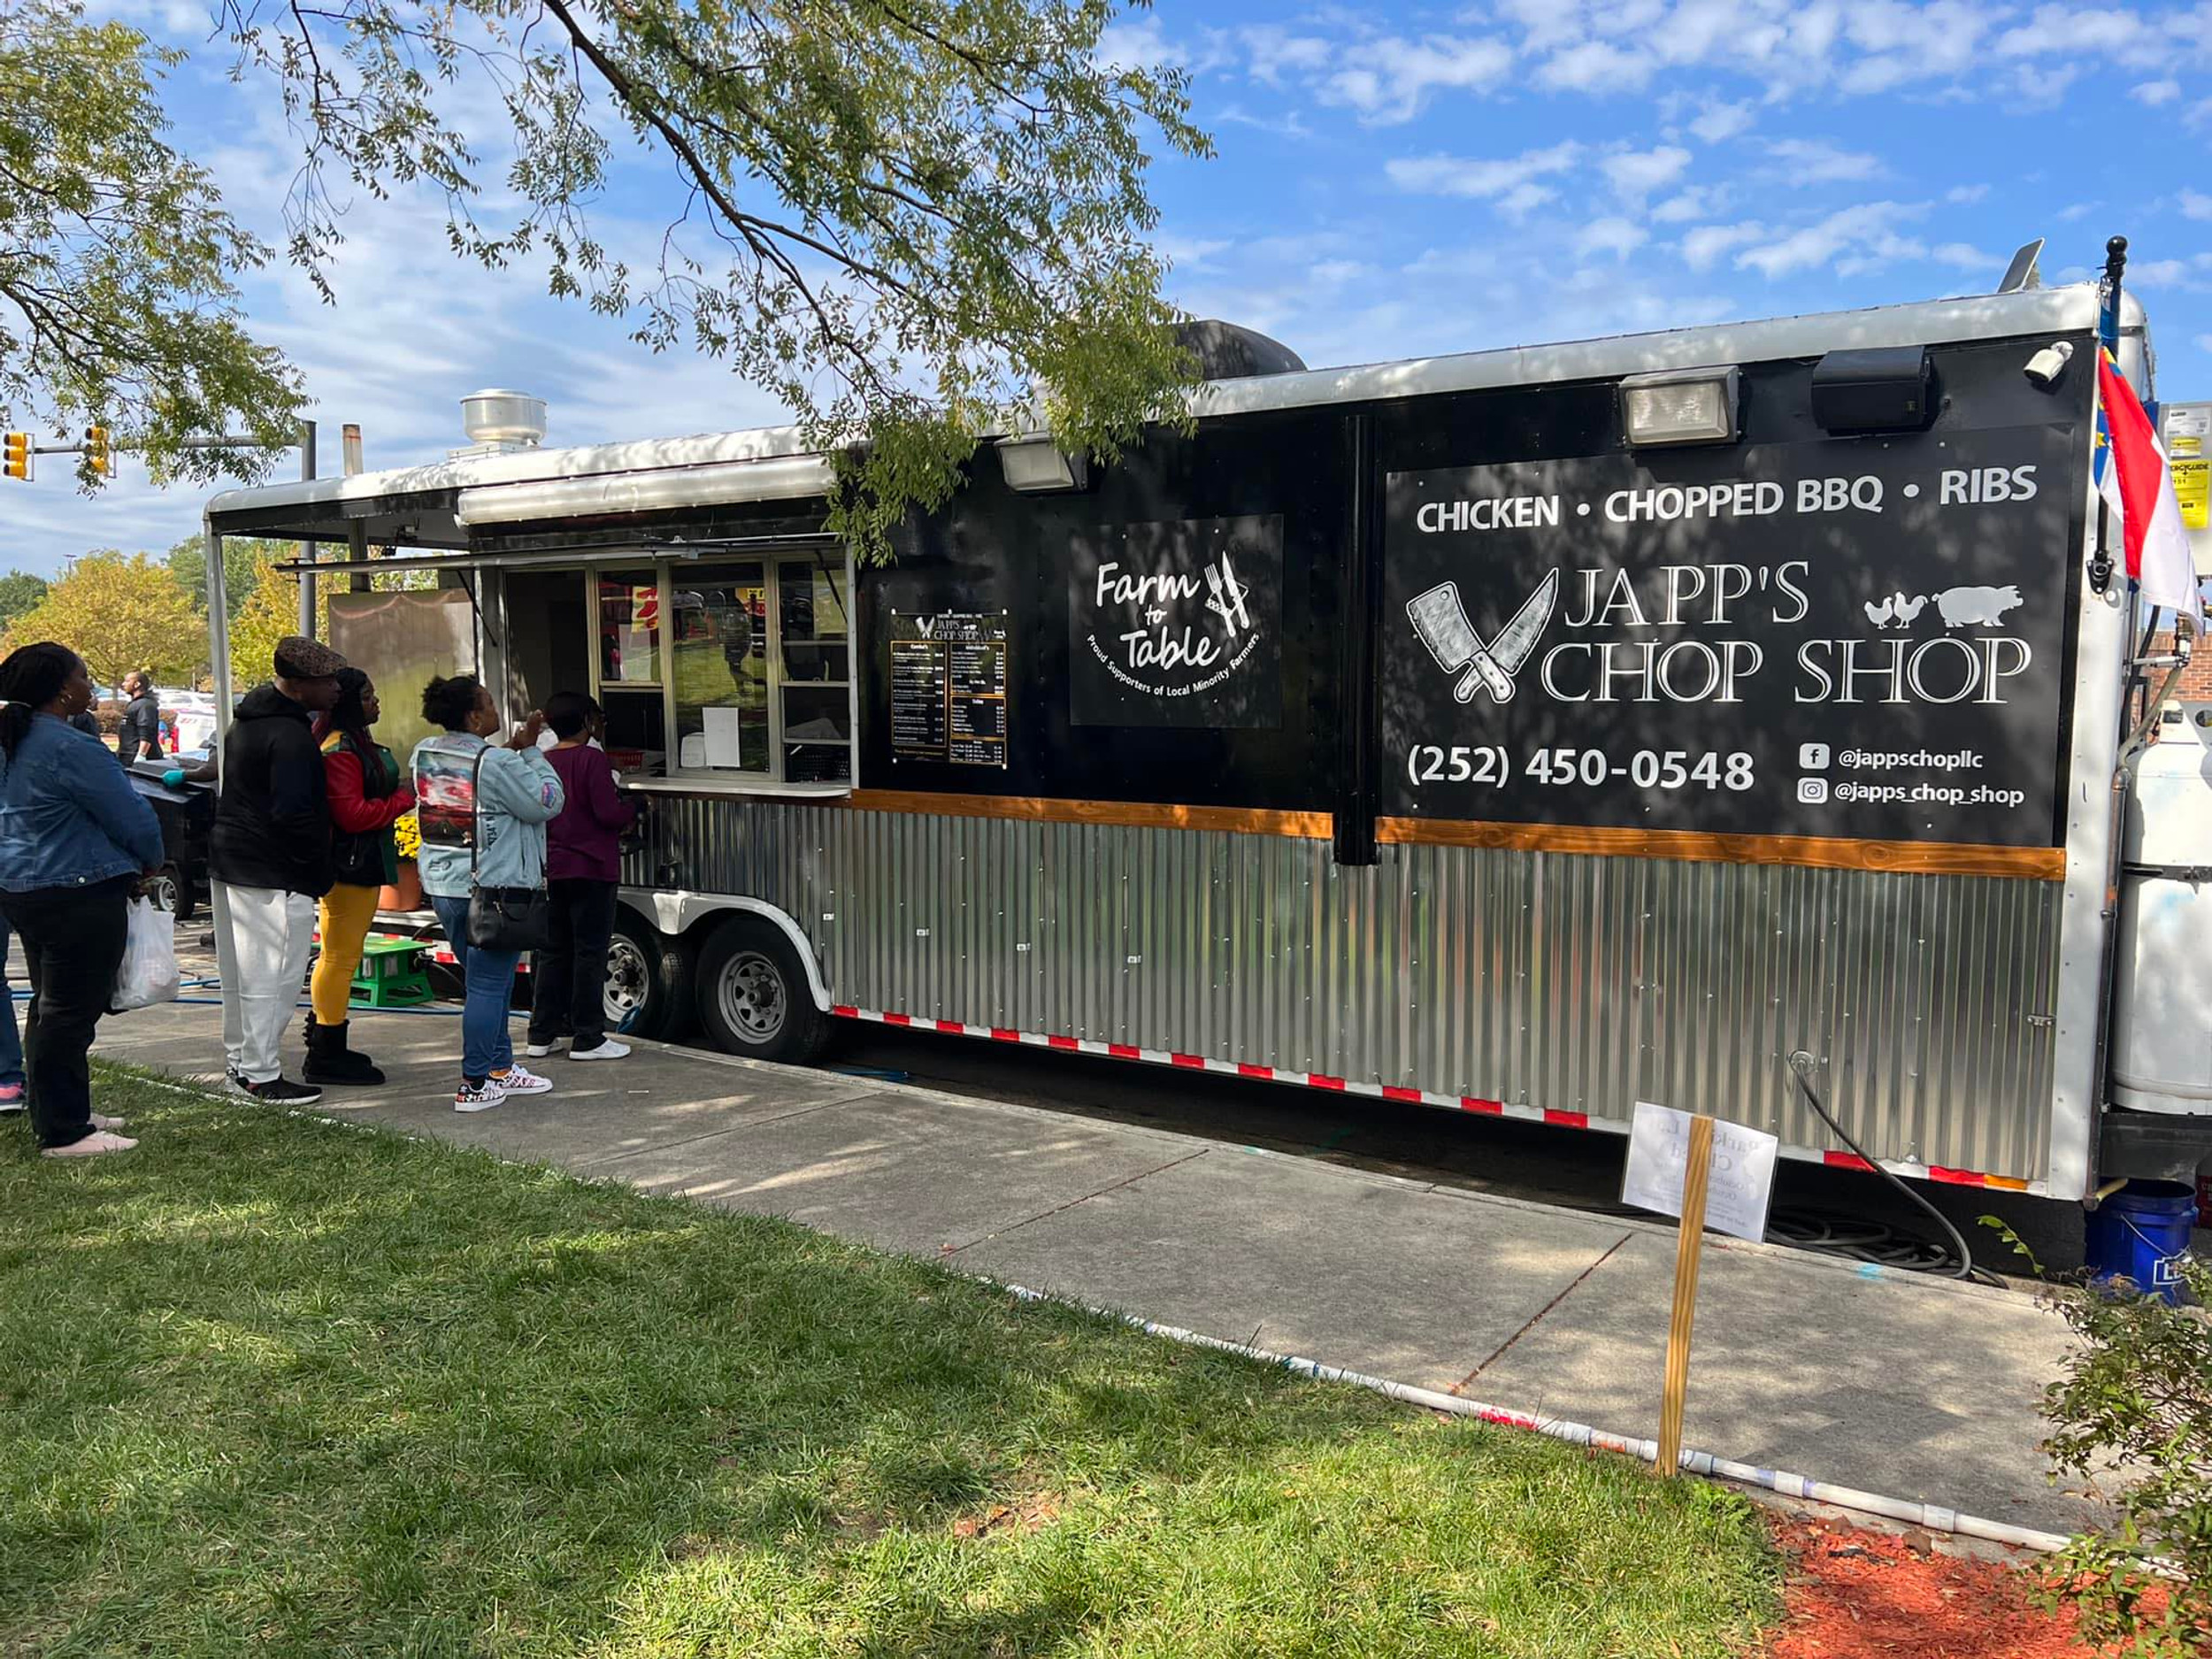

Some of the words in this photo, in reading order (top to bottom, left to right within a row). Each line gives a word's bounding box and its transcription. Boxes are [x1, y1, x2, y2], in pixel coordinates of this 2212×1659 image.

[1417, 494, 1560, 533] CHICKEN
[1604, 481, 1785, 523] CHOPPED
[1796, 474, 1884, 514] BBQ
[1939, 465, 2038, 505] RIBS
[1096, 562, 1201, 607] Farm
[1564, 561, 1809, 627] JAPP'S
[1145, 604, 1168, 626] to
[1087, 634, 1108, 664] Proud
[1107, 660, 1151, 694] Supporters
[1154, 686, 1164, 695] of
[1166, 684, 1190, 697] Local
[1193, 667, 1230, 693] Minority
[1229, 632, 1260, 670] Farmers
[1118, 625, 1221, 671] Table
[1540, 639, 1763, 703] CHOP
[1793, 637, 2032, 704] SHOP
[1408, 744, 1509, 789] (252)
[1525, 748, 1755, 792] 450-0548
[1839, 749, 1984, 772] @jappschopllc
[1834, 781, 2024, 808] @japps_chop_shop
